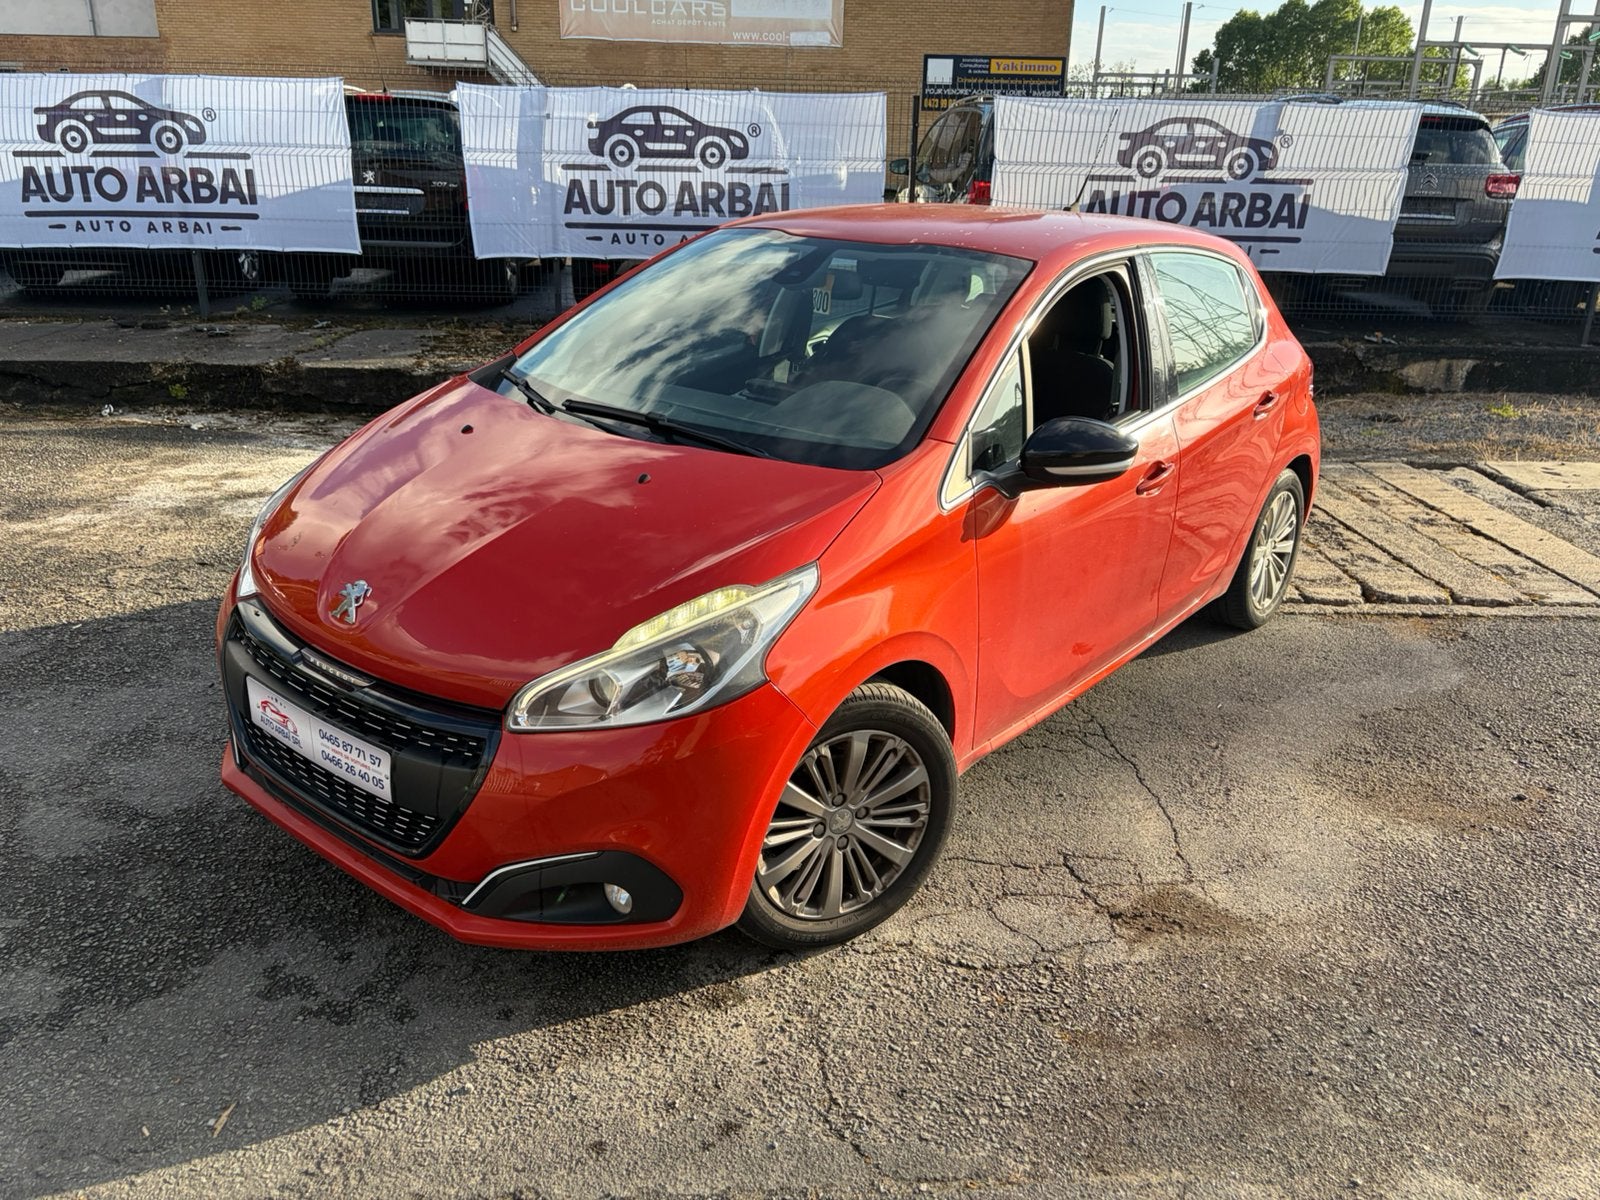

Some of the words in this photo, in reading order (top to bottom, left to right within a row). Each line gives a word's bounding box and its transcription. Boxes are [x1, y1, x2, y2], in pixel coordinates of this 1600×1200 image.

[995, 61, 1057, 72] Yakimmo
[21, 165, 128, 203] AUTO
[136, 166, 258, 205] ARBAI
[564, 179, 667, 216] AUTO
[673, 181, 790, 217] ARBAI
[1086, 190, 1188, 224] AUTO
[1190, 191, 1312, 229] ARBAI
[75, 219, 132, 233] AUTO
[147, 220, 213, 235] ARBAI
[611, 233, 665, 245] AUTO
[310, 657, 354, 683] PEUGEOT
[260, 715, 274, 730] AUTO
[319, 728, 341, 748] 0465
[342, 740, 354, 755] 87
[355, 747, 367, 761] 71
[369, 754, 382, 768] 57
[321, 750, 343, 769] 0466
[344, 762, 356, 776] 26
[358, 770, 370, 783] 40
[372, 779, 385, 790] 05
